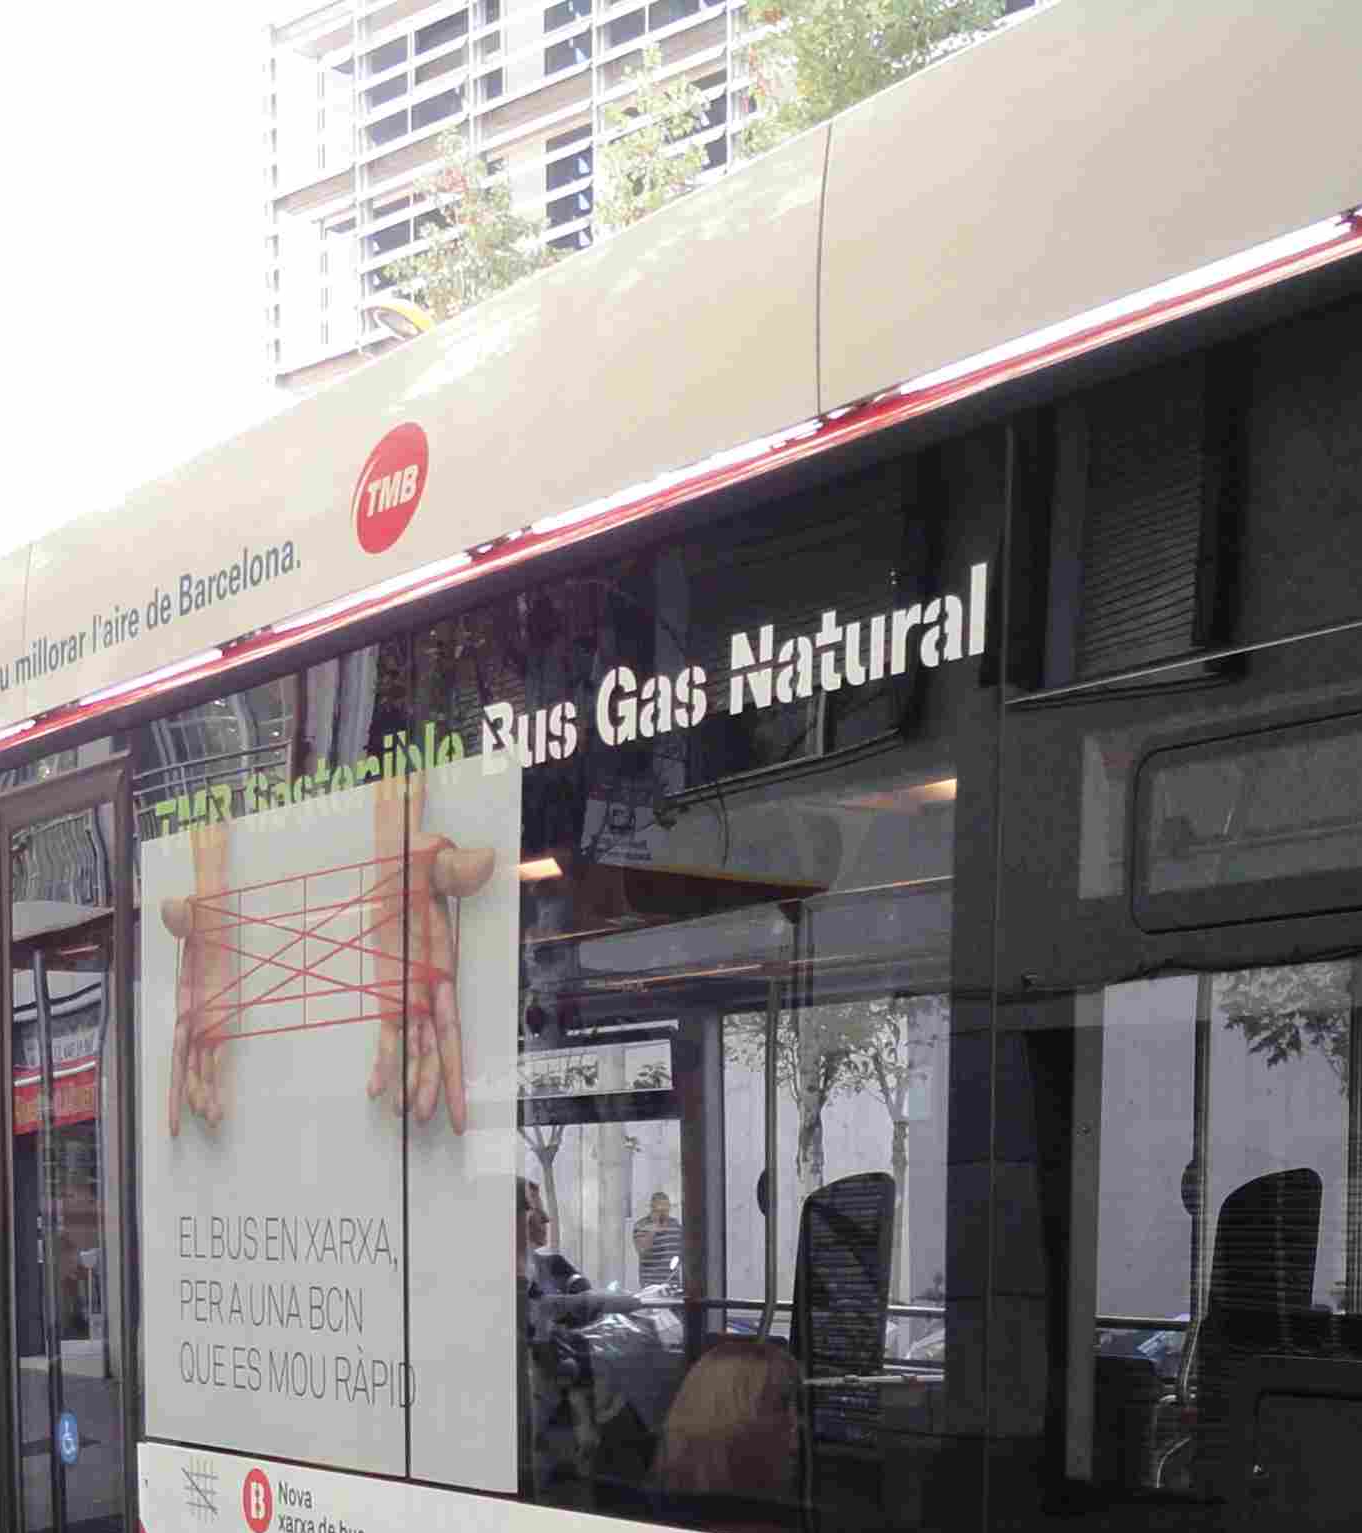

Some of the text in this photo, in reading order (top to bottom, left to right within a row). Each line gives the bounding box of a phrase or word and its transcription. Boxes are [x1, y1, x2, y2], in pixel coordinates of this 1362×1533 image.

[367, 464, 419, 518] TMB
[15, 630, 87, 686] millorar
[92, 604, 139, 654] l'aire
[146, 587, 172, 630] de
[179, 539, 302, 617] Barcelona.
[481, 701, 579, 777] Bus
[596, 665, 708, 747] Gas
[728, 561, 989, 715] Natural
[180, 1216, 398, 1272] EL BUS EN XARXA,
[180, 1279, 364, 1335] PER A UNA BCN
[180, 1341, 227, 1387] QUE
[232, 1346, 262, 1391] ES
[269, 1350, 327, 1399] MOU
[278, 1481, 314, 1509] Nova
